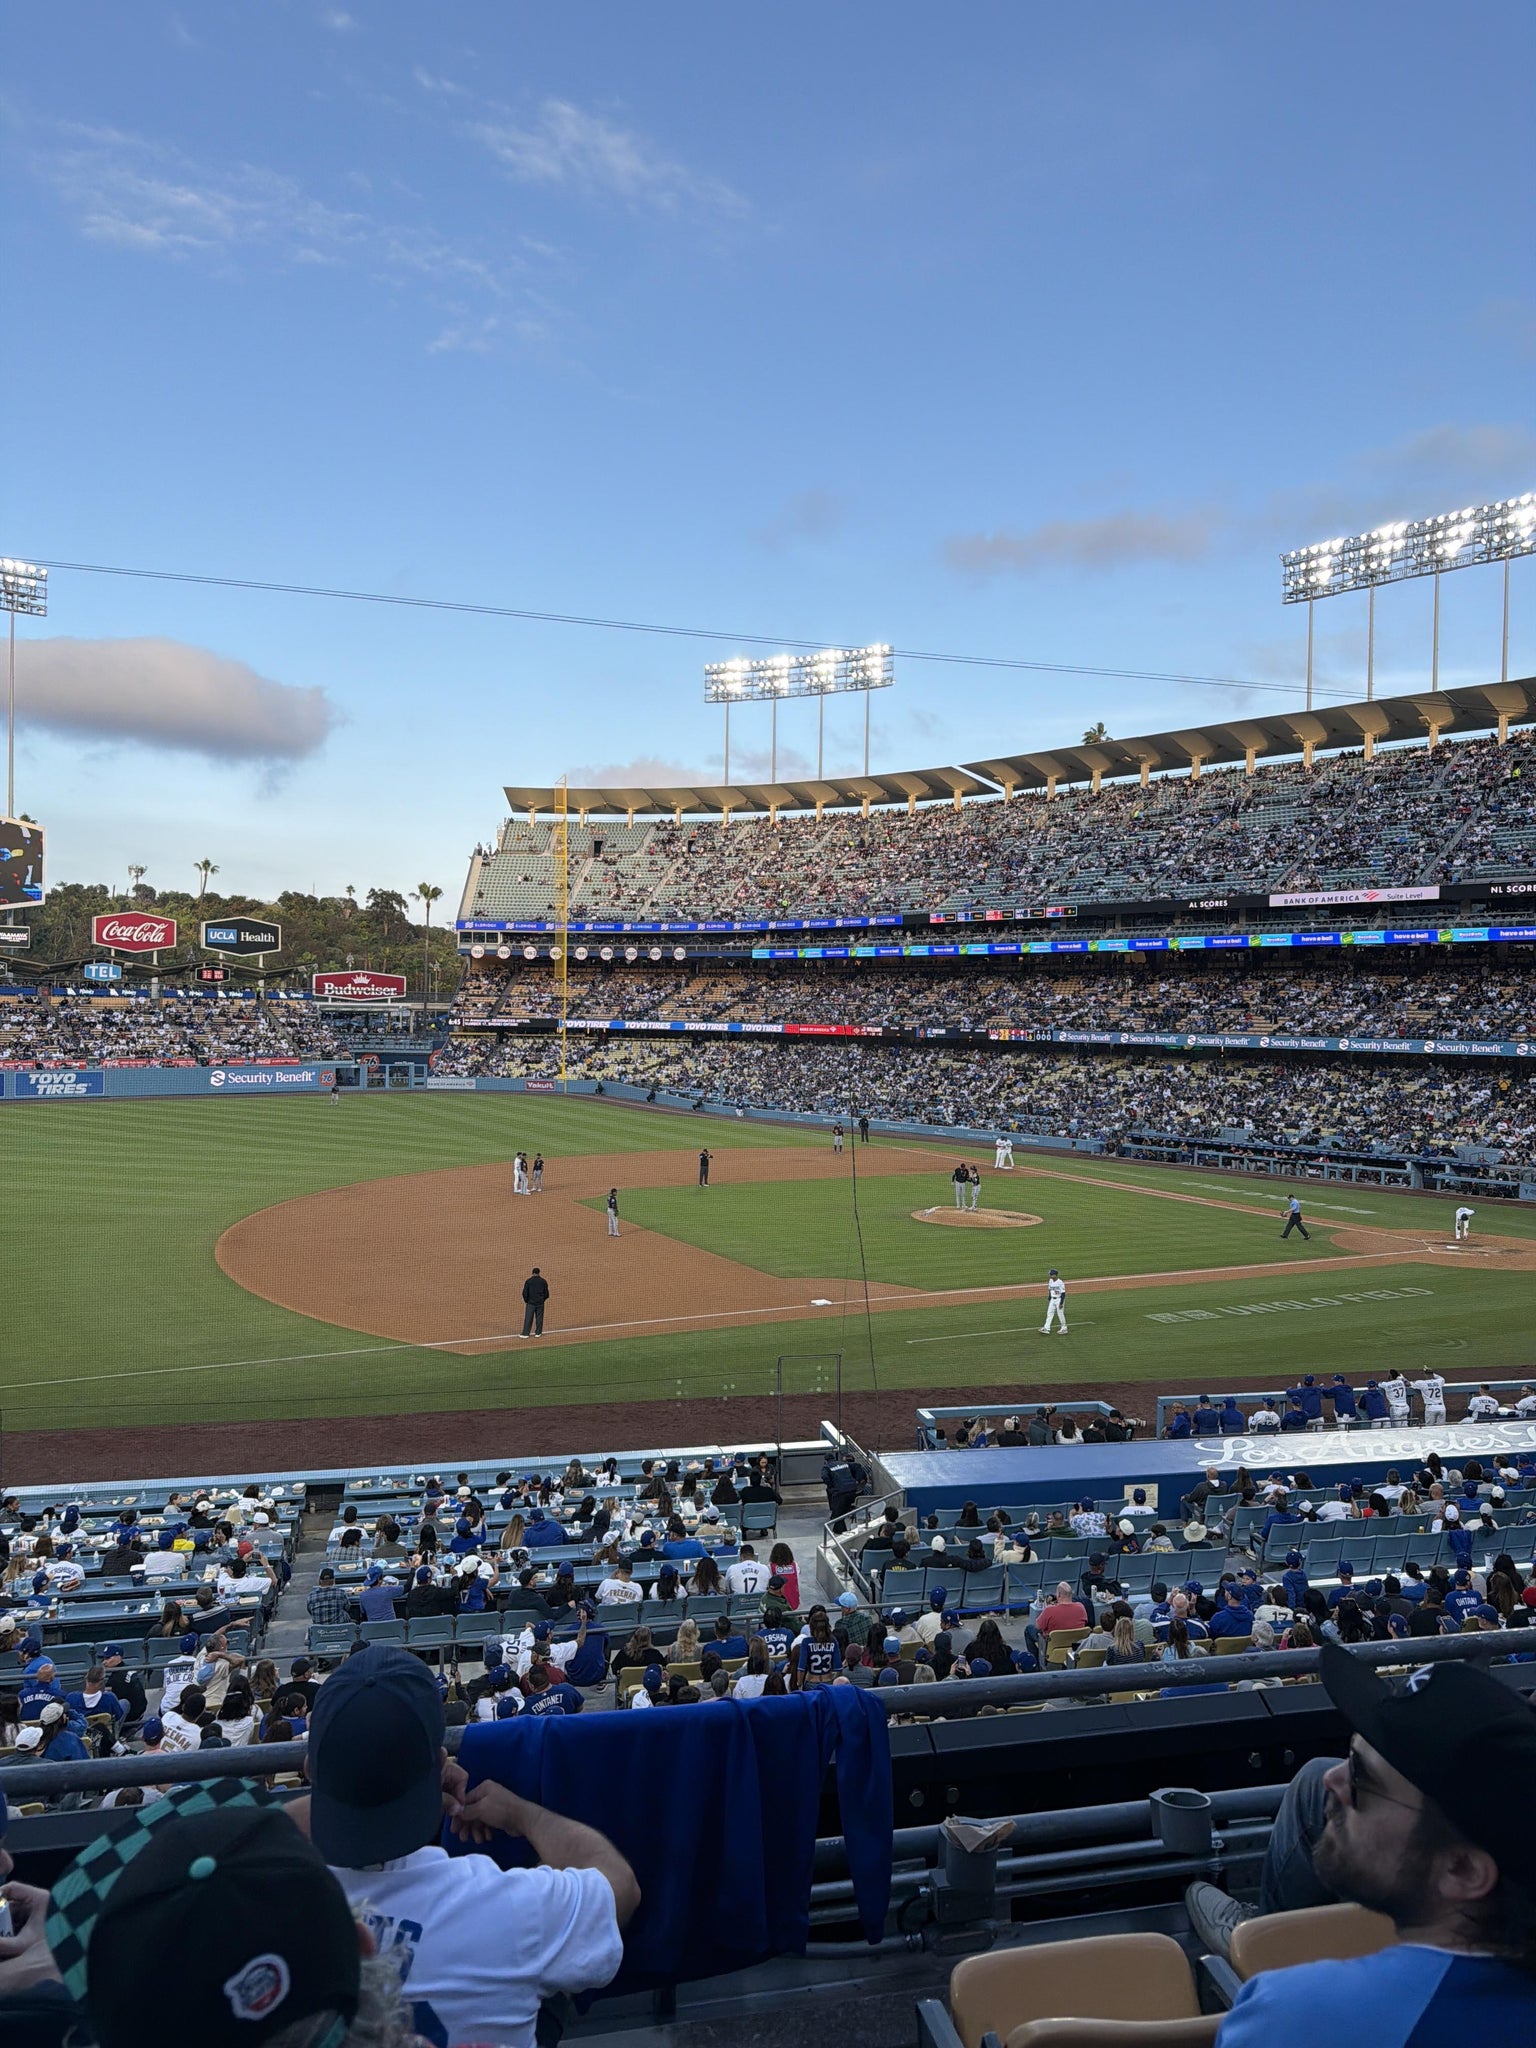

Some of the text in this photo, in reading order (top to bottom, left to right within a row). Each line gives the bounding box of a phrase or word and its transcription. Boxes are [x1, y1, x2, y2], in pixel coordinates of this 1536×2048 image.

[1491, 886, 1503, 894] NL
[1320, 895, 1360, 903] AMERICA
[103, 921, 168, 943] Coca-Cola
[210, 931, 274, 943] UCLA Health
[88, 966, 117, 978] TEL
[324, 982, 397, 996] Budweiser
[707, 1023, 728, 1031] TIRES
[741, 1023, 782, 1032] TOYO TIRES
[1067, 1033, 1111, 1041] Security Benefit
[1130, 1034, 1177, 1043] Security Benefit
[1197, 1037, 1223, 1046] Security
[1270, 1039, 1299, 1047] Security
[1350, 1041, 1410, 1050] Security Benefit
[1436, 1043, 1501, 1052] Security Benefit
[364, 1058, 376, 1068] 76
[29, 1073, 76, 1084] TOYO
[228, 1071, 312, 1085] Security Benefit
[322, 1073, 333, 1082] 76
[37, 1083, 88, 1095] TIRES
[1216, 1287, 1434, 1315] UNIQLO FIELD
[1393, 1388, 1405, 1398] 37
[1428, 1388, 1441, 1398] 72
[1485, 1405, 1491, 1414] 5
[1194, 1438, 1294, 1466] Los
[1296, 1432, 1511, 1456] Angeles
[50, 1566, 78, 1576] ERSHISER
[743, 1577, 757, 1593] 17
[610, 1589, 636, 1599] FREEMAN
[1456, 1598, 1477, 1606] OHTANI
[1272, 1611, 1288, 1620] 17
[765, 1633, 787, 1643] ERSHAW
[808, 1642, 835, 1652] TUCKER
[810, 1654, 832, 1673] 23
[24, 1695, 34, 1704] LOS
[531, 1694, 563, 1714] FONTANET
[163, 1726, 191, 1751] REEMAN
